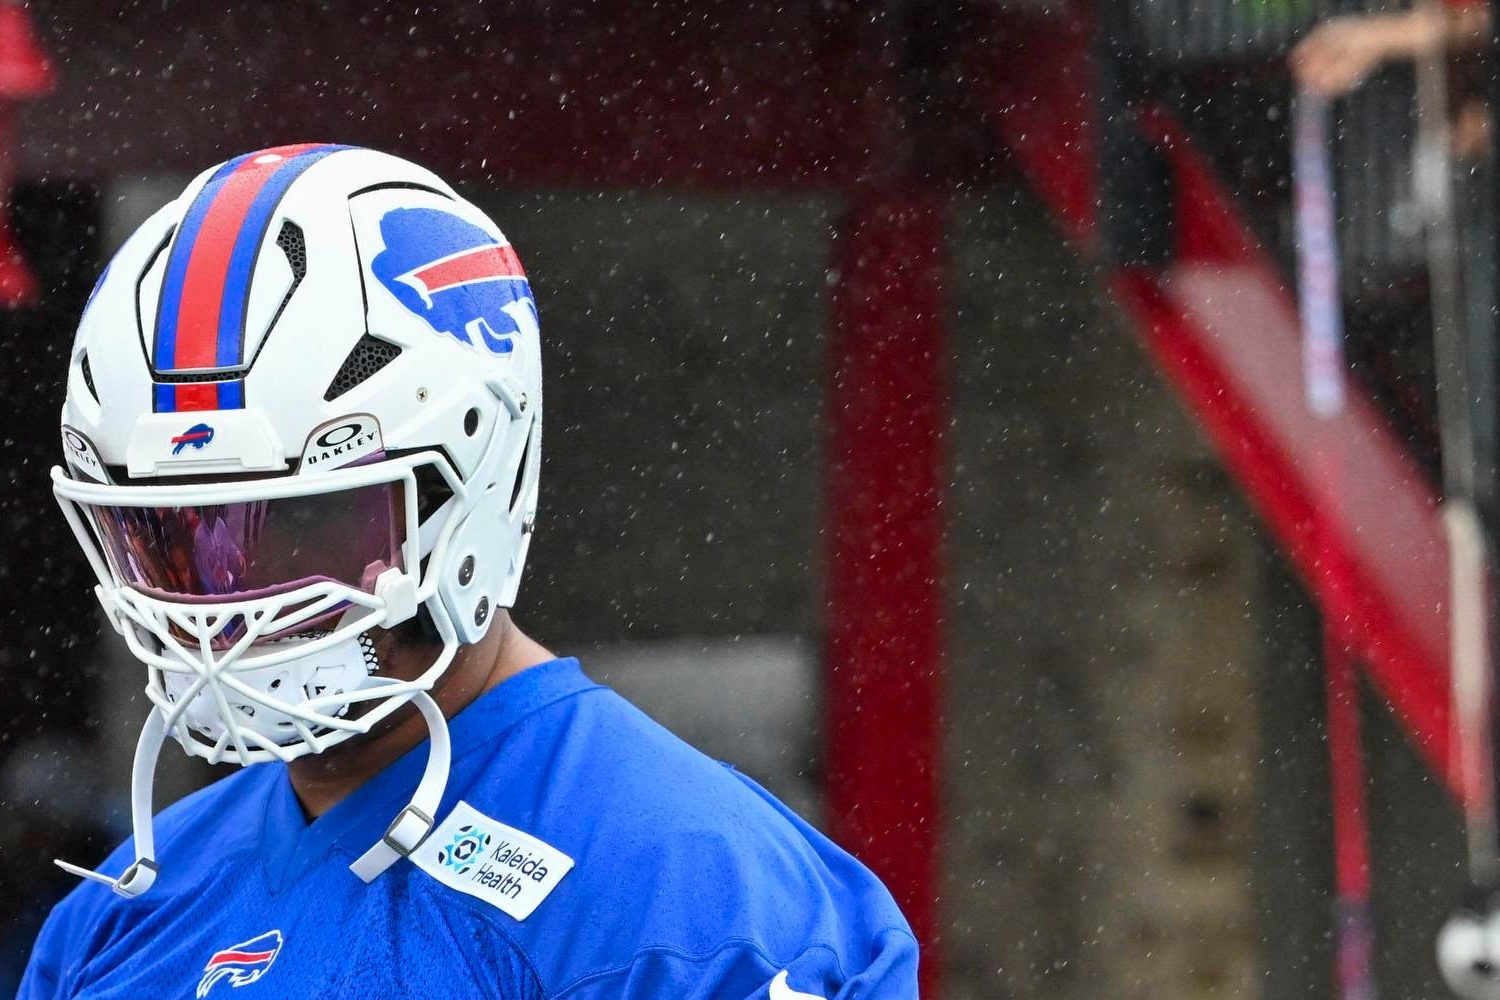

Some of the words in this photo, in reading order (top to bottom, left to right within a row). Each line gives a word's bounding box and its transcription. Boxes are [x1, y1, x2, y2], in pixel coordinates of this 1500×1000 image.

[308, 432, 374, 464] OAKLEY
[490, 840, 548, 882] Kaleida
[471, 862, 522, 899] Health
